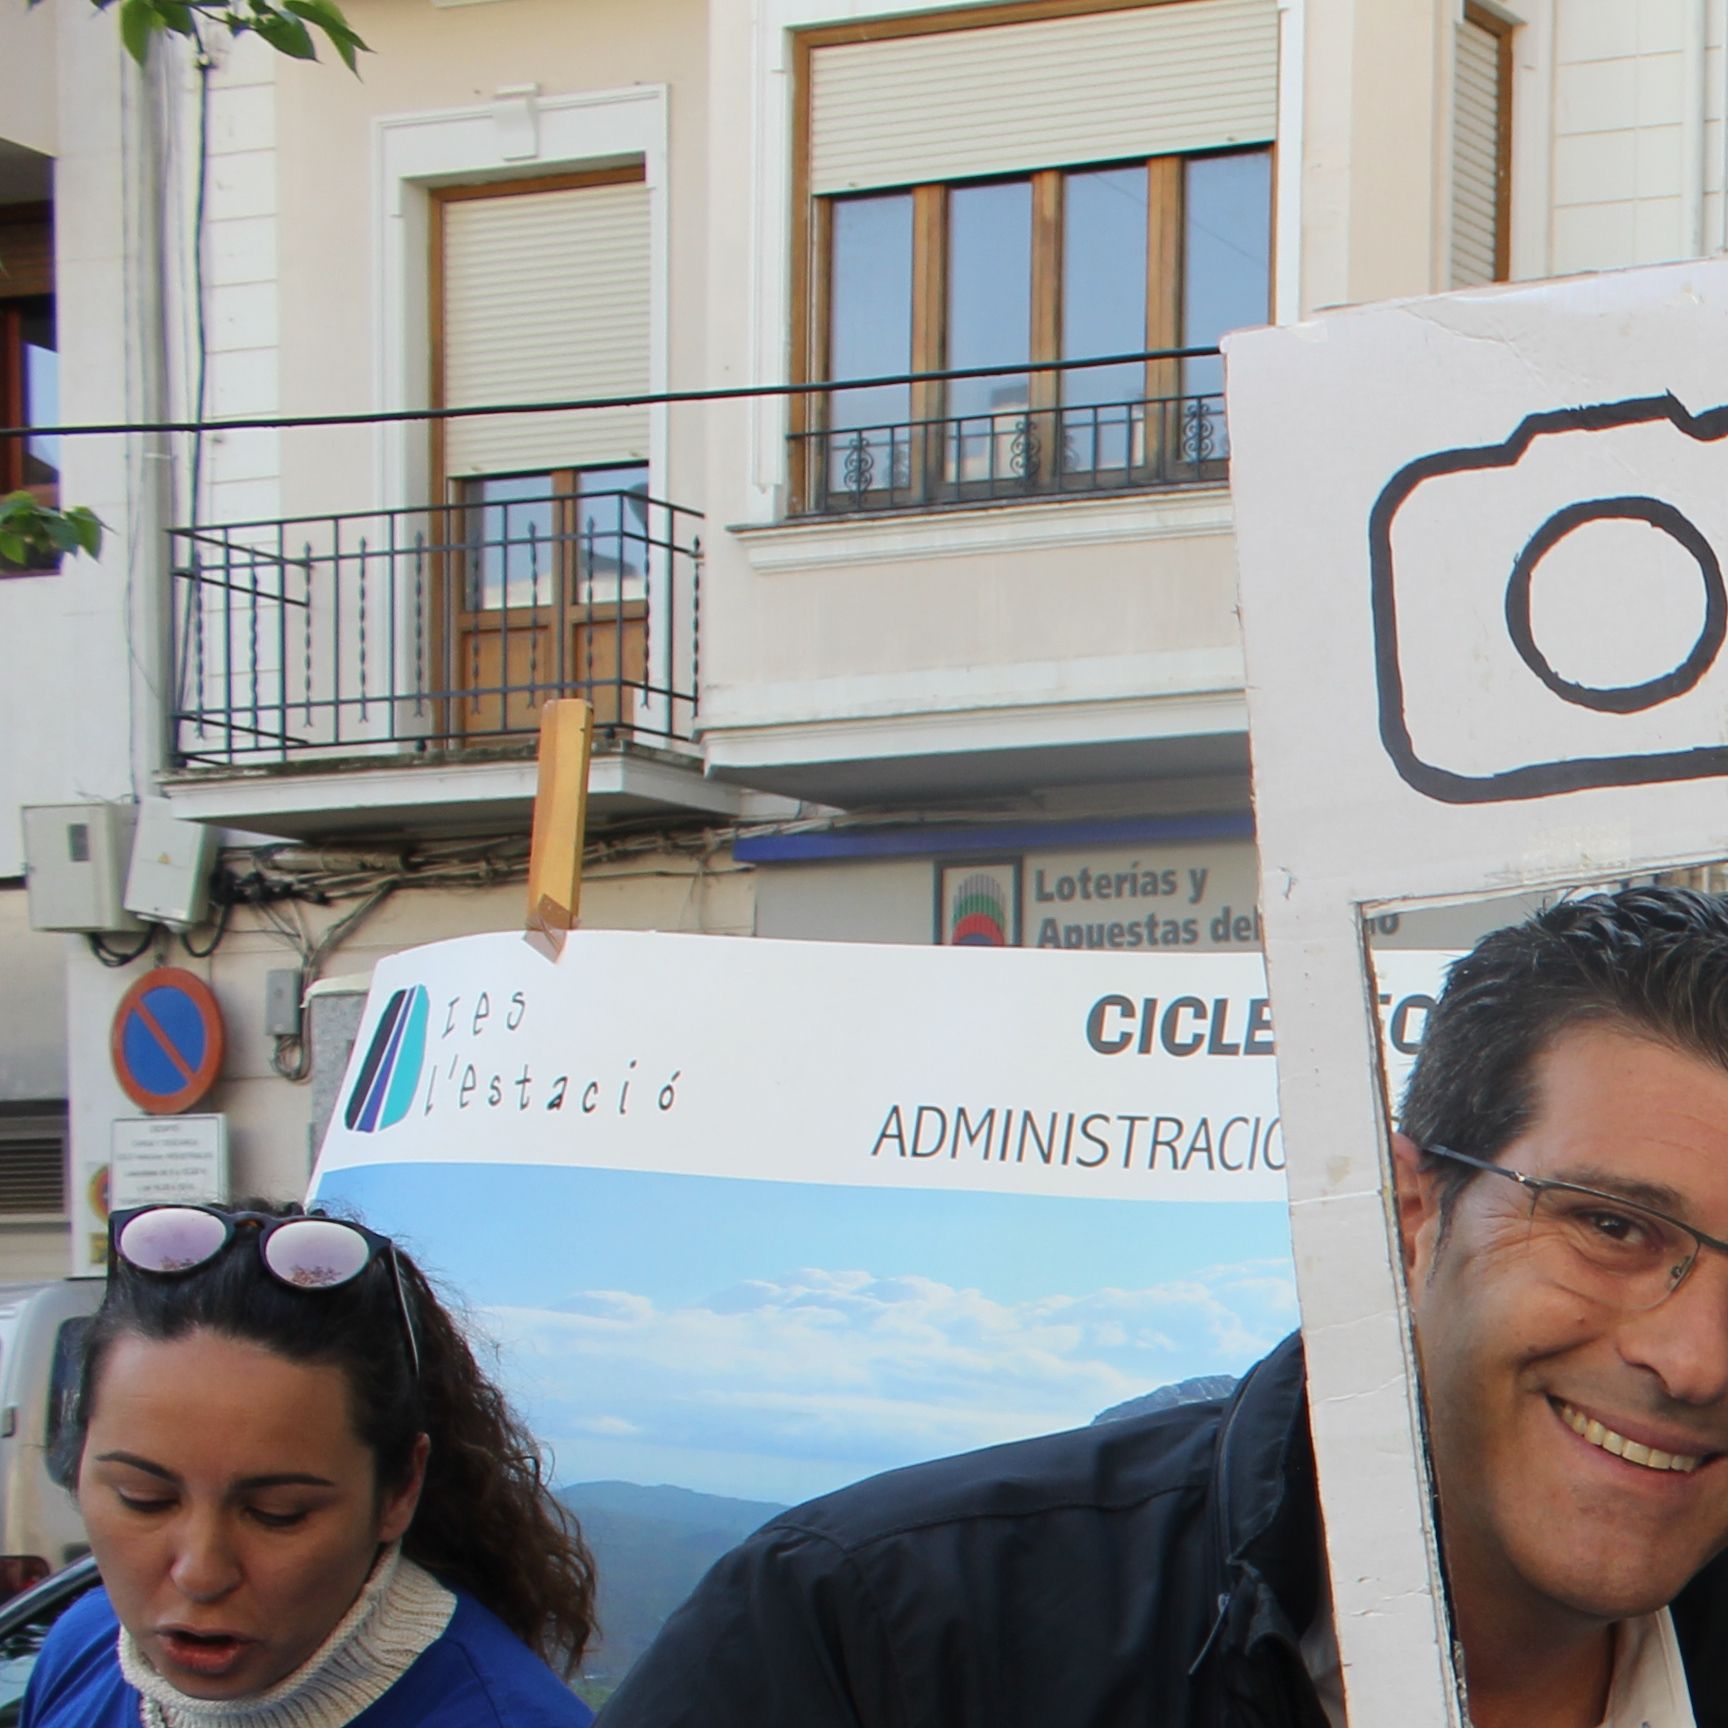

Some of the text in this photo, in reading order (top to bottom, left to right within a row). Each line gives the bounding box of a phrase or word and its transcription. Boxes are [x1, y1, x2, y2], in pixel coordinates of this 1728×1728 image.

[1035, 862, 1208, 904] Loterías y
[1037, 912, 1199, 949] Apuestas
[424, 1054, 682, 1117] l'estació
